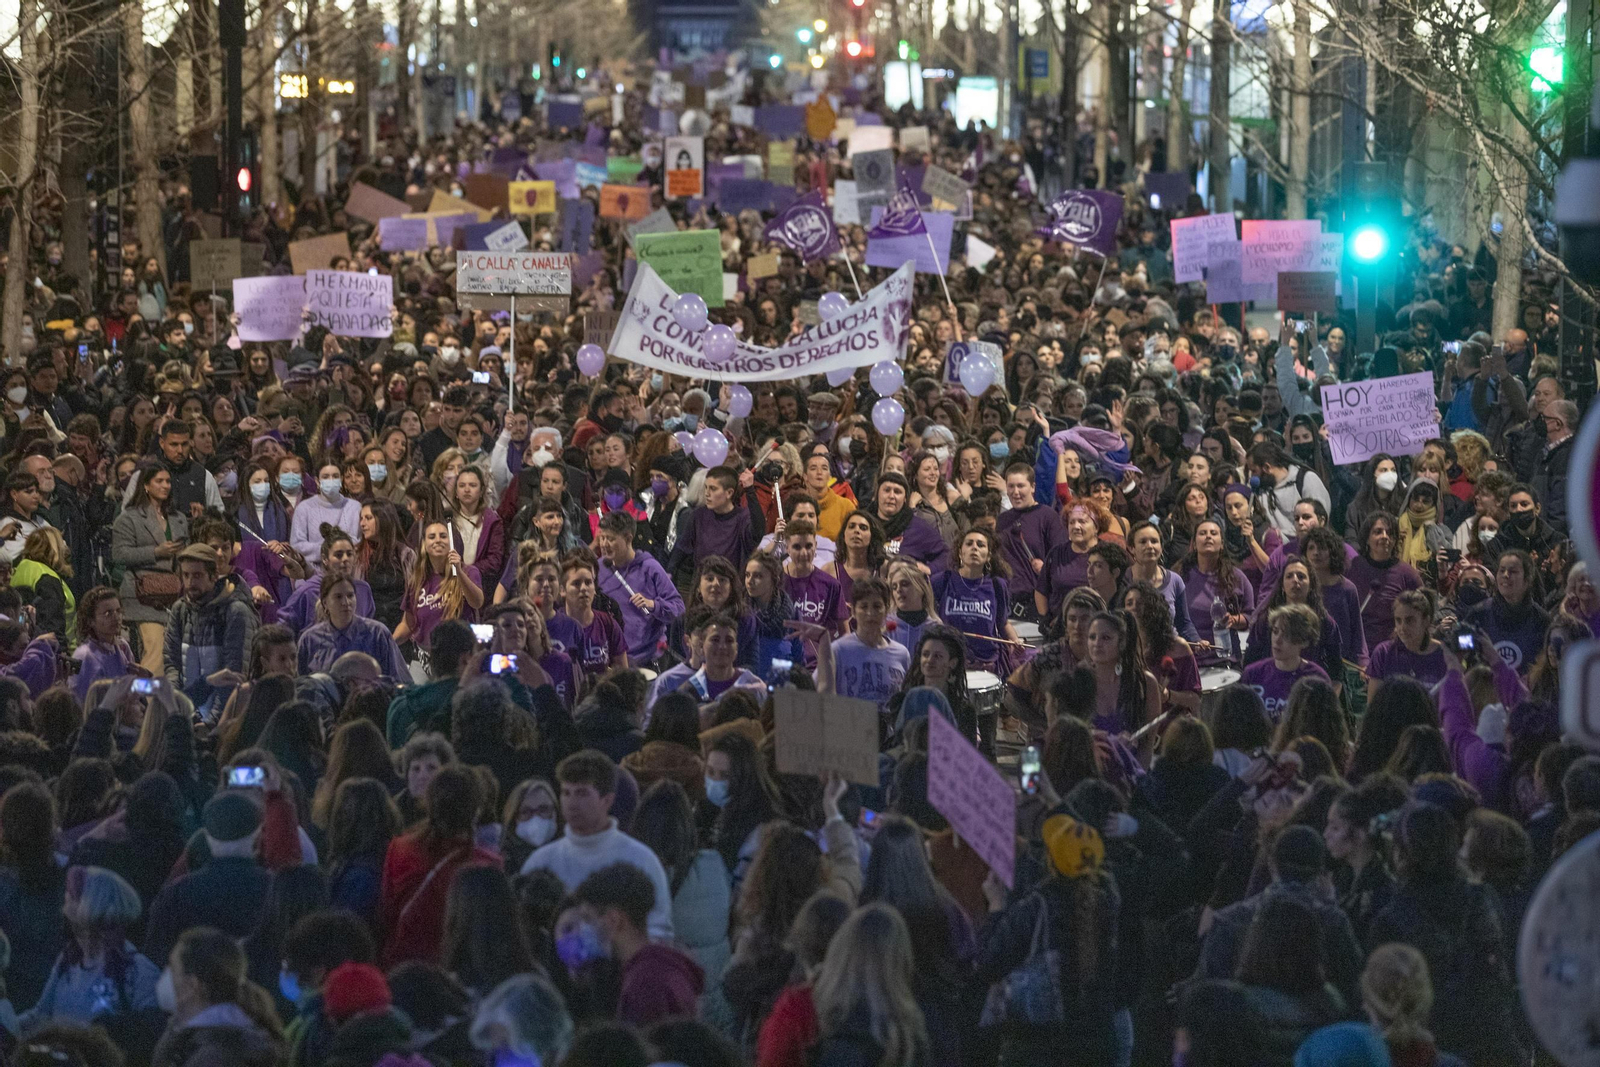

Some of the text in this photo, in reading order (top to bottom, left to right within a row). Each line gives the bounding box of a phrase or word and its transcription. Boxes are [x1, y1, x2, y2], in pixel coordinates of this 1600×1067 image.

[476, 256, 516, 271] CALLA
[522, 256, 570, 271] CANALLA
[314, 273, 388, 292] HERMANA
[817, 306, 879, 340] LUCHA
[640, 330, 880, 374] POR NUESTROS DERECHOS
[1324, 377, 1420, 411] HOY HAREMOS
[1376, 393, 1394, 406] QUE
[1356, 409, 1413, 429] TEMBLADO
[1360, 406, 1373, 415] POR
[1378, 403, 1394, 412] CADA
[1331, 425, 1411, 461] NOSOTRAS
[945, 595, 992, 616] CLITORIS
